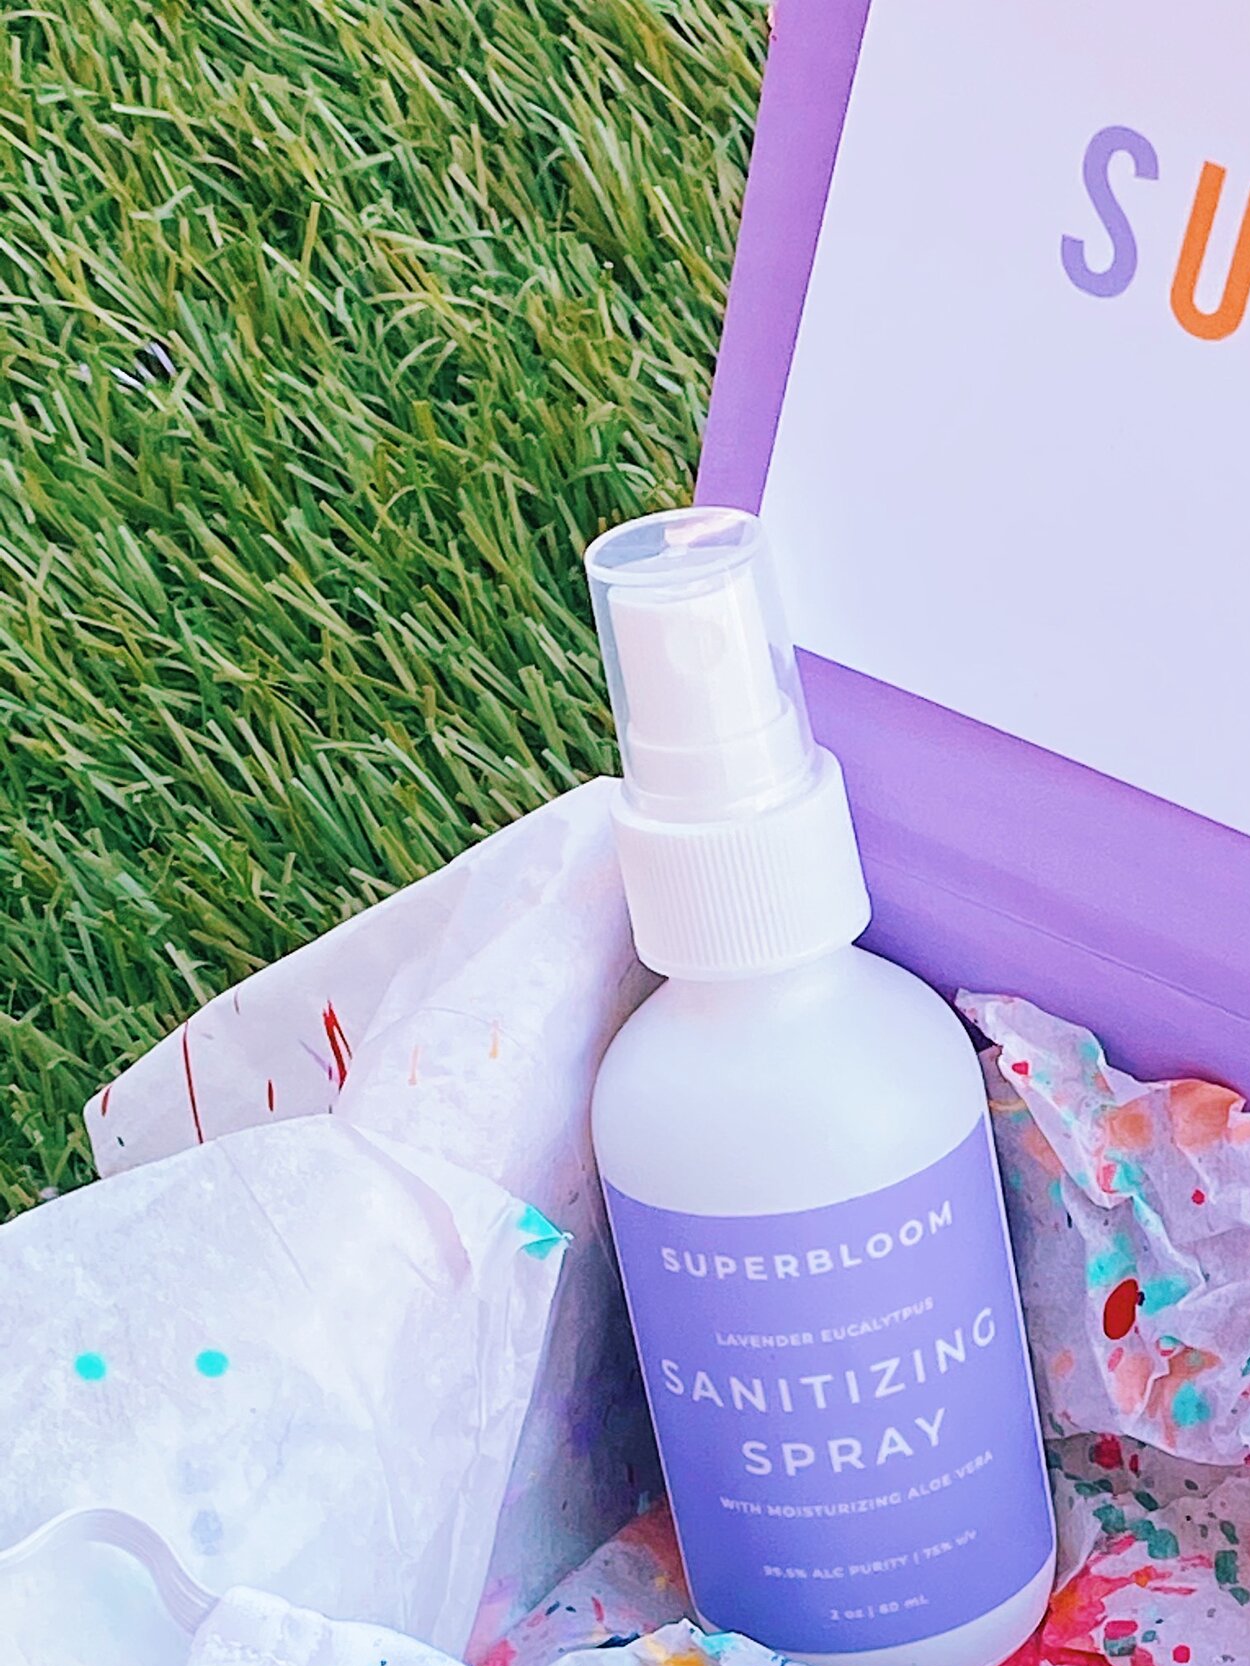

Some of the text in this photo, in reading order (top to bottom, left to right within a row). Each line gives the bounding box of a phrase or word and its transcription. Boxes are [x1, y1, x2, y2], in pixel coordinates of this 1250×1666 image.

[661, 1200, 952, 1281] SUPERBLOOM
[661, 1307, 995, 1413] SANITIZING
[715, 1332, 814, 1349] LAVENDER
[741, 1407, 945, 1477] SPRAY
[719, 1450, 993, 1518] WITH MOISTURIZING ALOE VERA
[811, 1566, 845, 1579] ALC
[848, 1555, 908, 1577] PURITY
